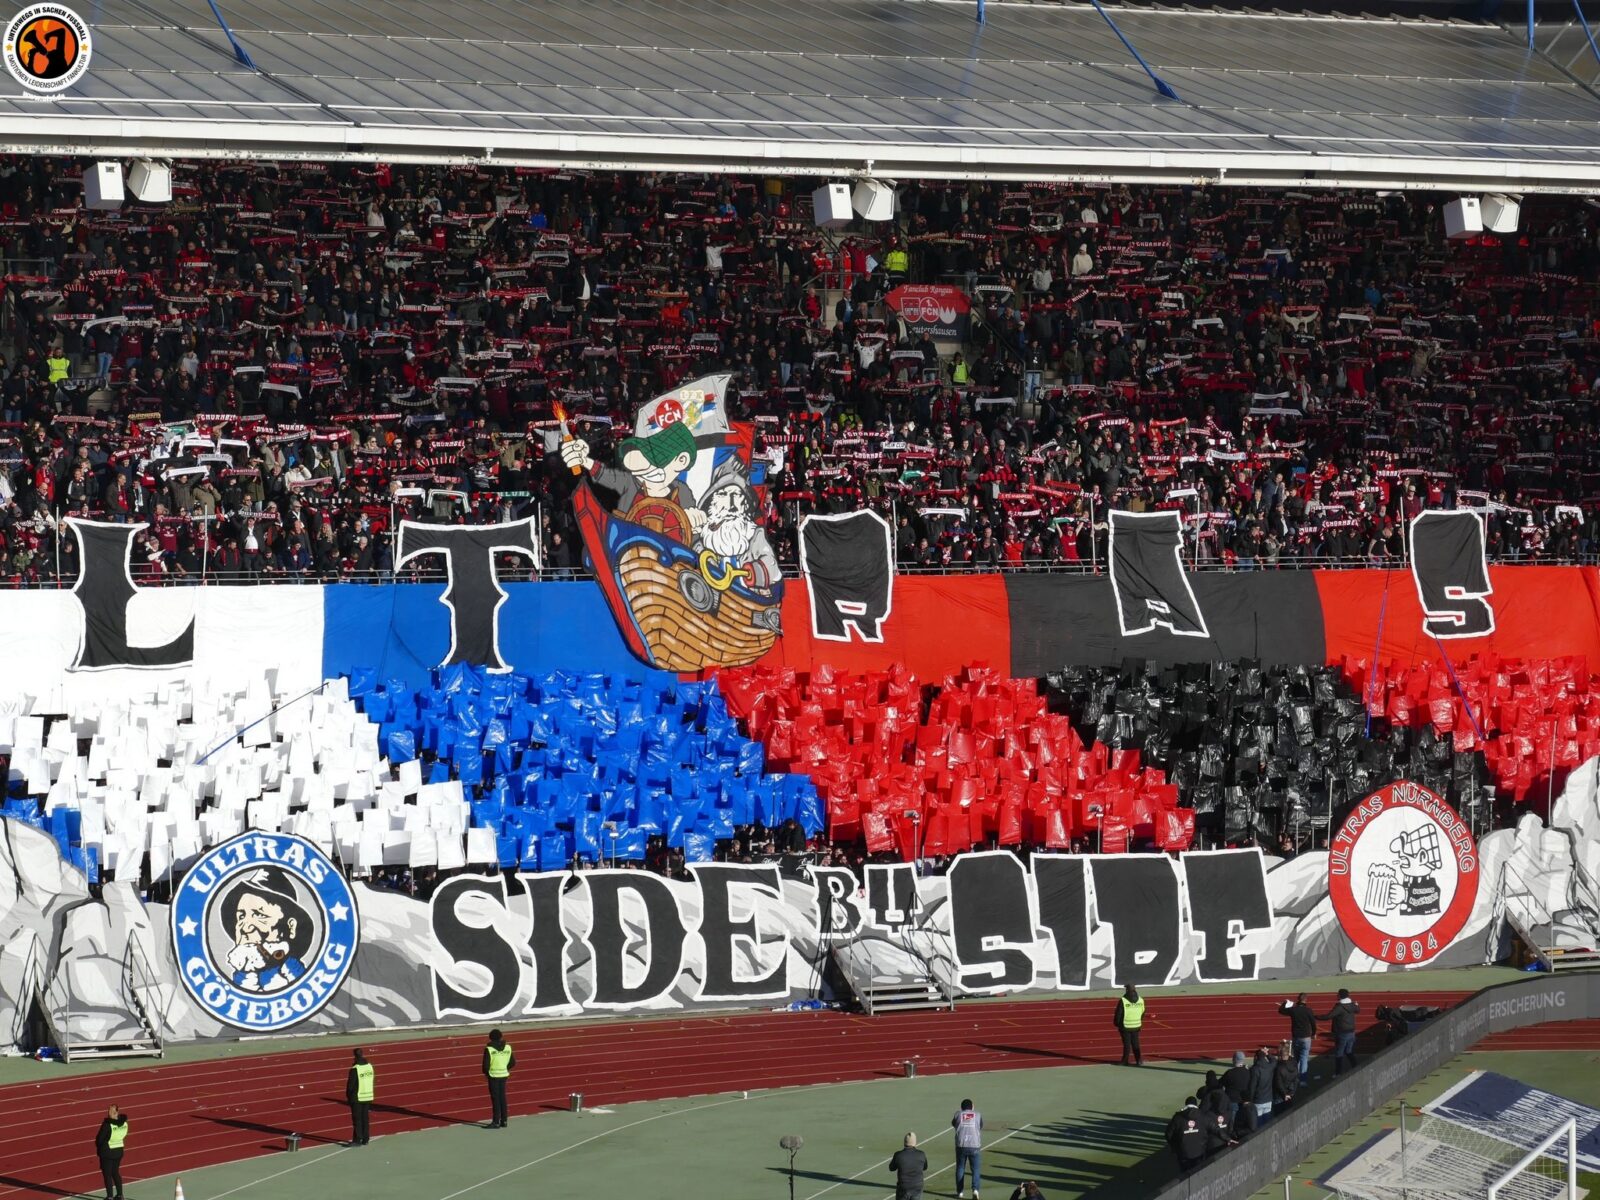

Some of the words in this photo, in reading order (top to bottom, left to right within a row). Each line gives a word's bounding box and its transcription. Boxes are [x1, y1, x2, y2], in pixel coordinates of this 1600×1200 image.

[903, 284, 928, 294] Fanclub
[921, 307, 938, 316] FCN
[663, 402, 672, 411] 1.
[658, 411, 682, 426] FCN
[128, 446, 146, 454] CLUB
[1331, 796, 1383, 875] ULTRAS
[1391, 783, 1475, 873] NÜRNBERG
[187, 836, 330, 894] ULTRAS
[430, 861, 791, 1021] SIDE
[946, 846, 1275, 993] SIDE
[1381, 932, 1438, 961] 1994
[186, 942, 347, 1024] GÖTEBORG
